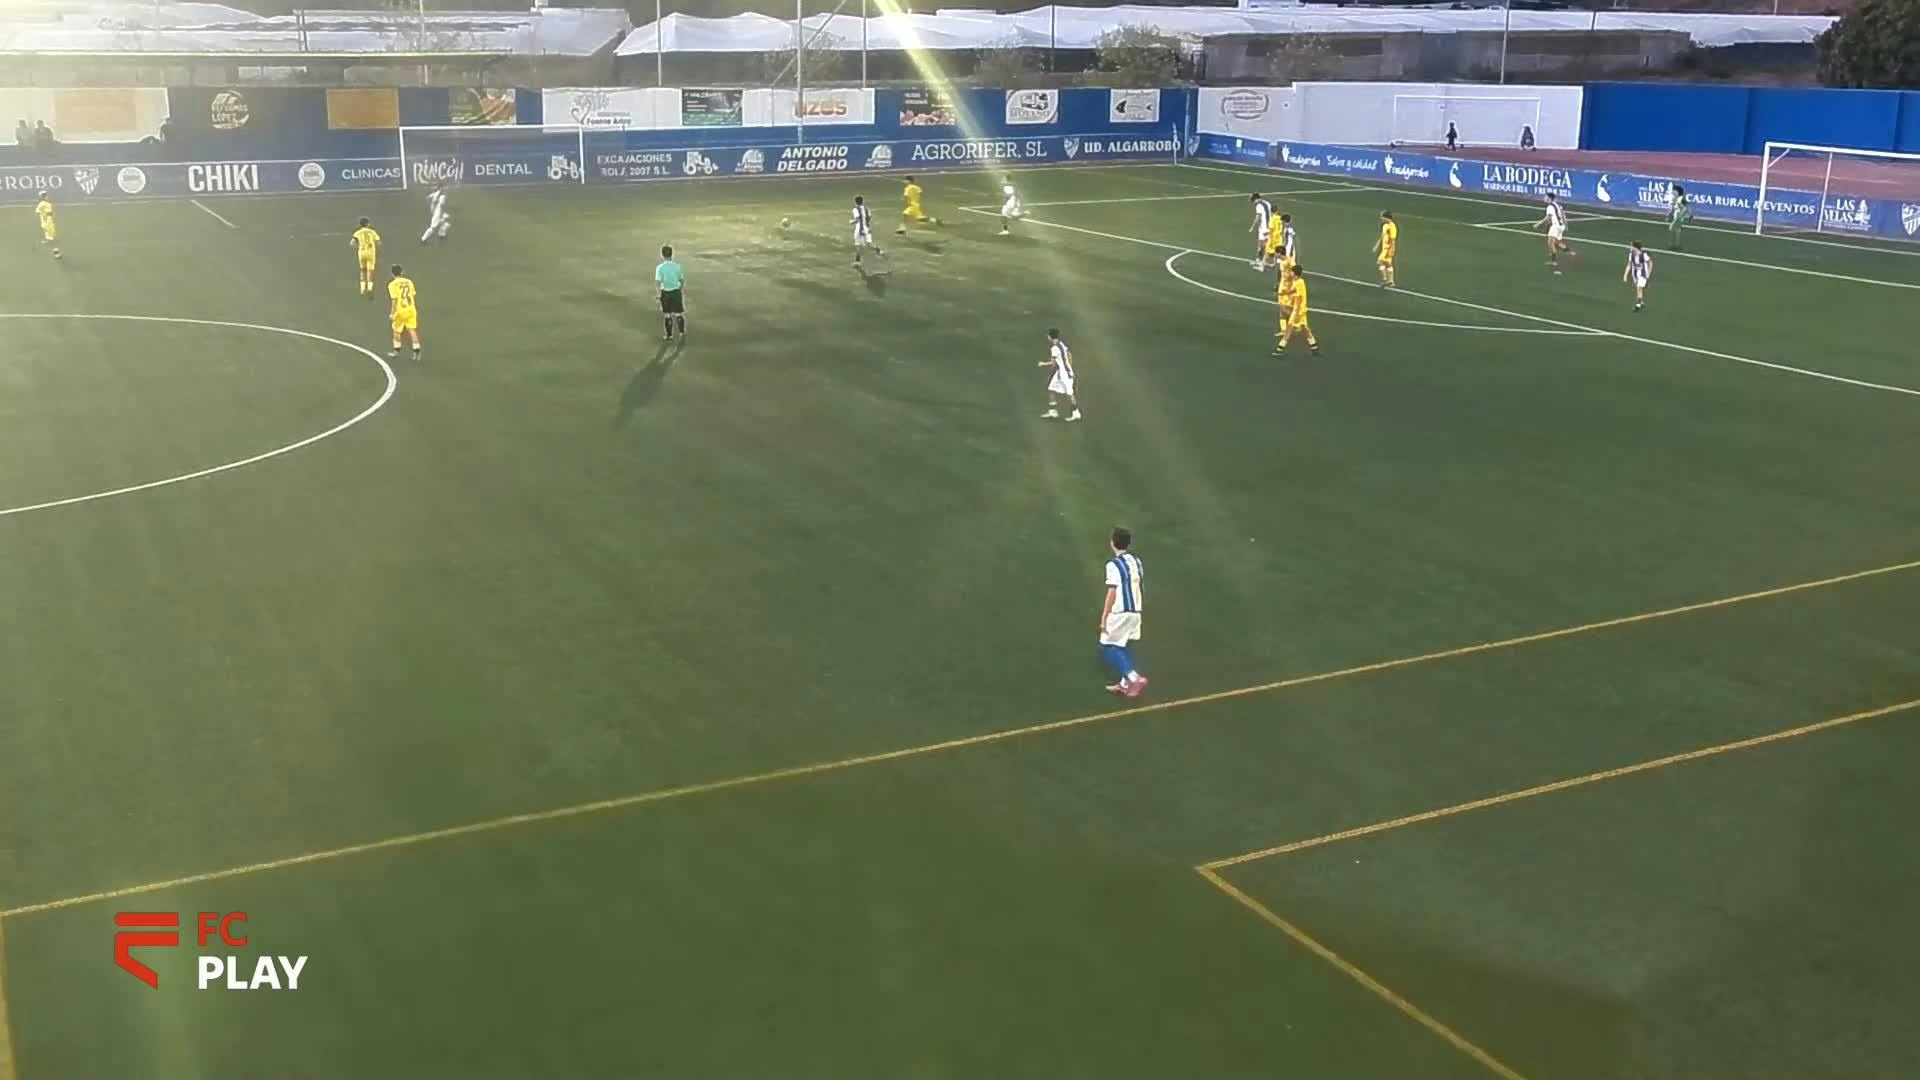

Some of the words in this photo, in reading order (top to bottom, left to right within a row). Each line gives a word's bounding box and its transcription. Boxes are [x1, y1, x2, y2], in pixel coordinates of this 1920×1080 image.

[781, 146, 848, 159] ANTONIO
[911, 143, 1021, 161] AGRORIFER,
[1025, 141, 1047, 157] SL
[1084, 142, 1105, 153] UD.
[1108, 140, 1181, 152] ALGARROBO
[475, 163, 532, 176] DENTAL
[777, 158, 848, 172] DELGADO
[188, 164, 259, 192] CHIKI
[341, 167, 401, 180] CLINICAS
[1483, 164, 1502, 182] LA
[1505, 166, 1572, 188] BODEGA
[0, 175, 62, 190] ROBO
[1648, 181, 1665, 193] LAS
[1685, 193, 1713, 205] CASA
[1715, 195, 1750, 208] RURAL
[1763, 201, 1815, 215] EVENTOS
[1836, 198, 1856, 211] LAS
